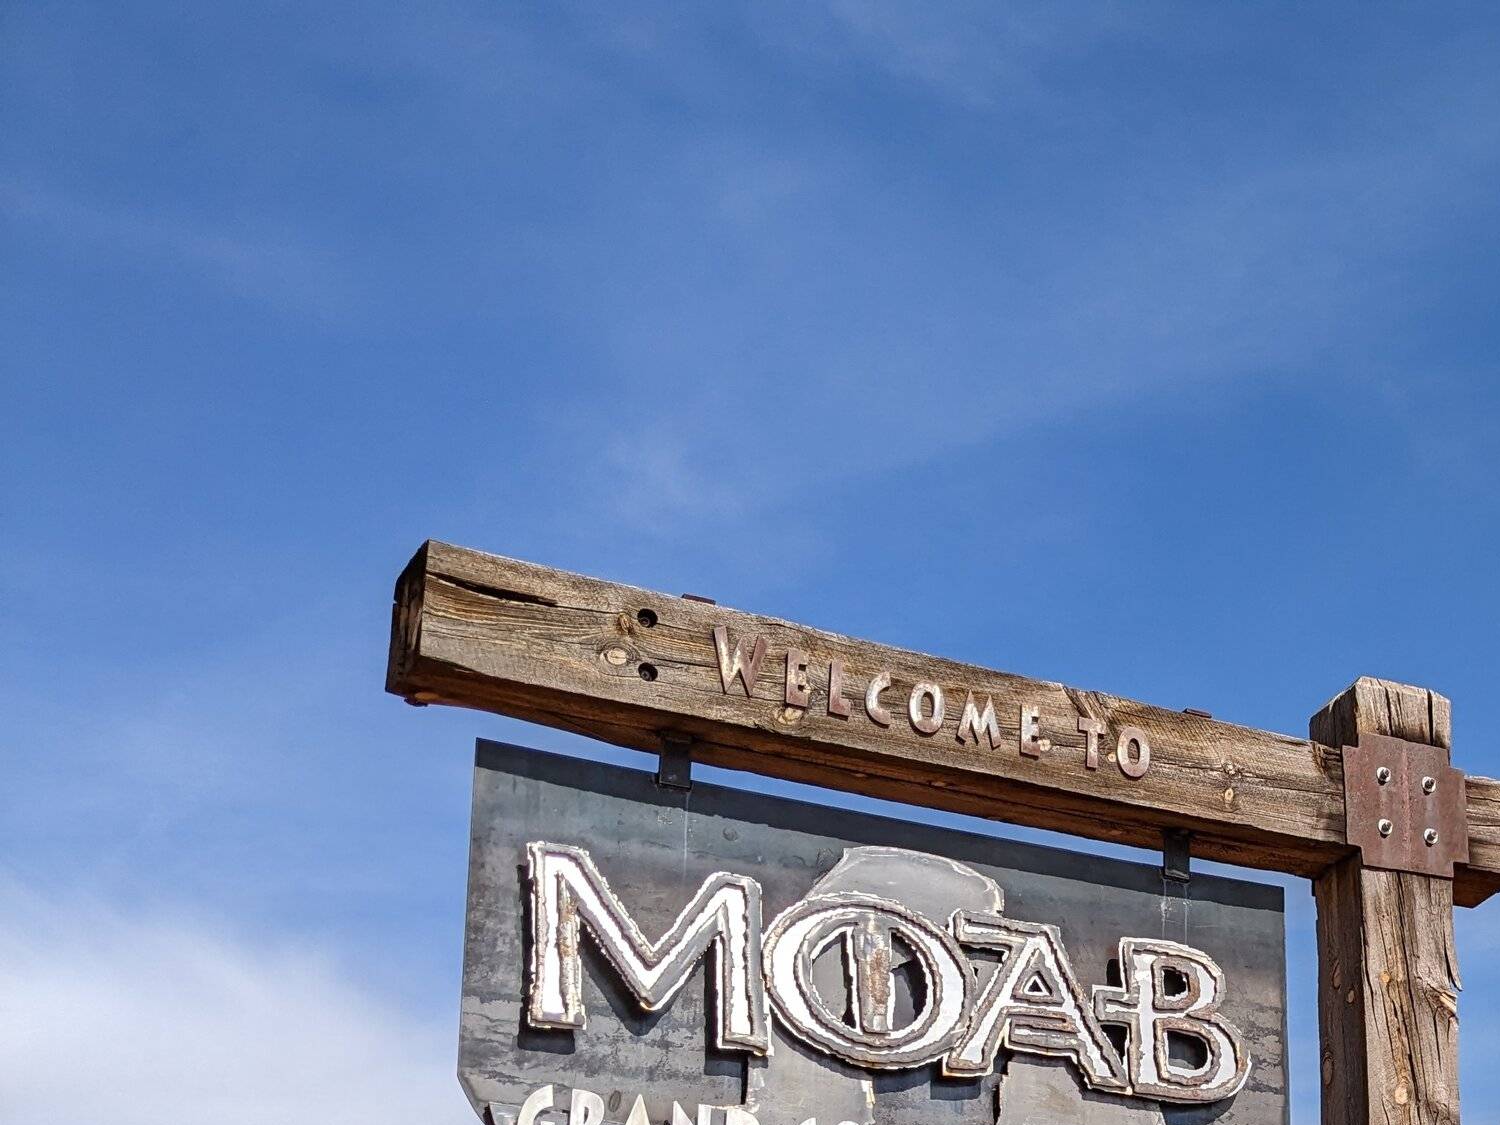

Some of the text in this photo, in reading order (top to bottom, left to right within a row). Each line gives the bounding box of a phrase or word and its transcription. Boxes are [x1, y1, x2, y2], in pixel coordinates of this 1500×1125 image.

[714, 626, 1152, 780] WELCOME TO
[525, 840, 1253, 1104] MOAB
